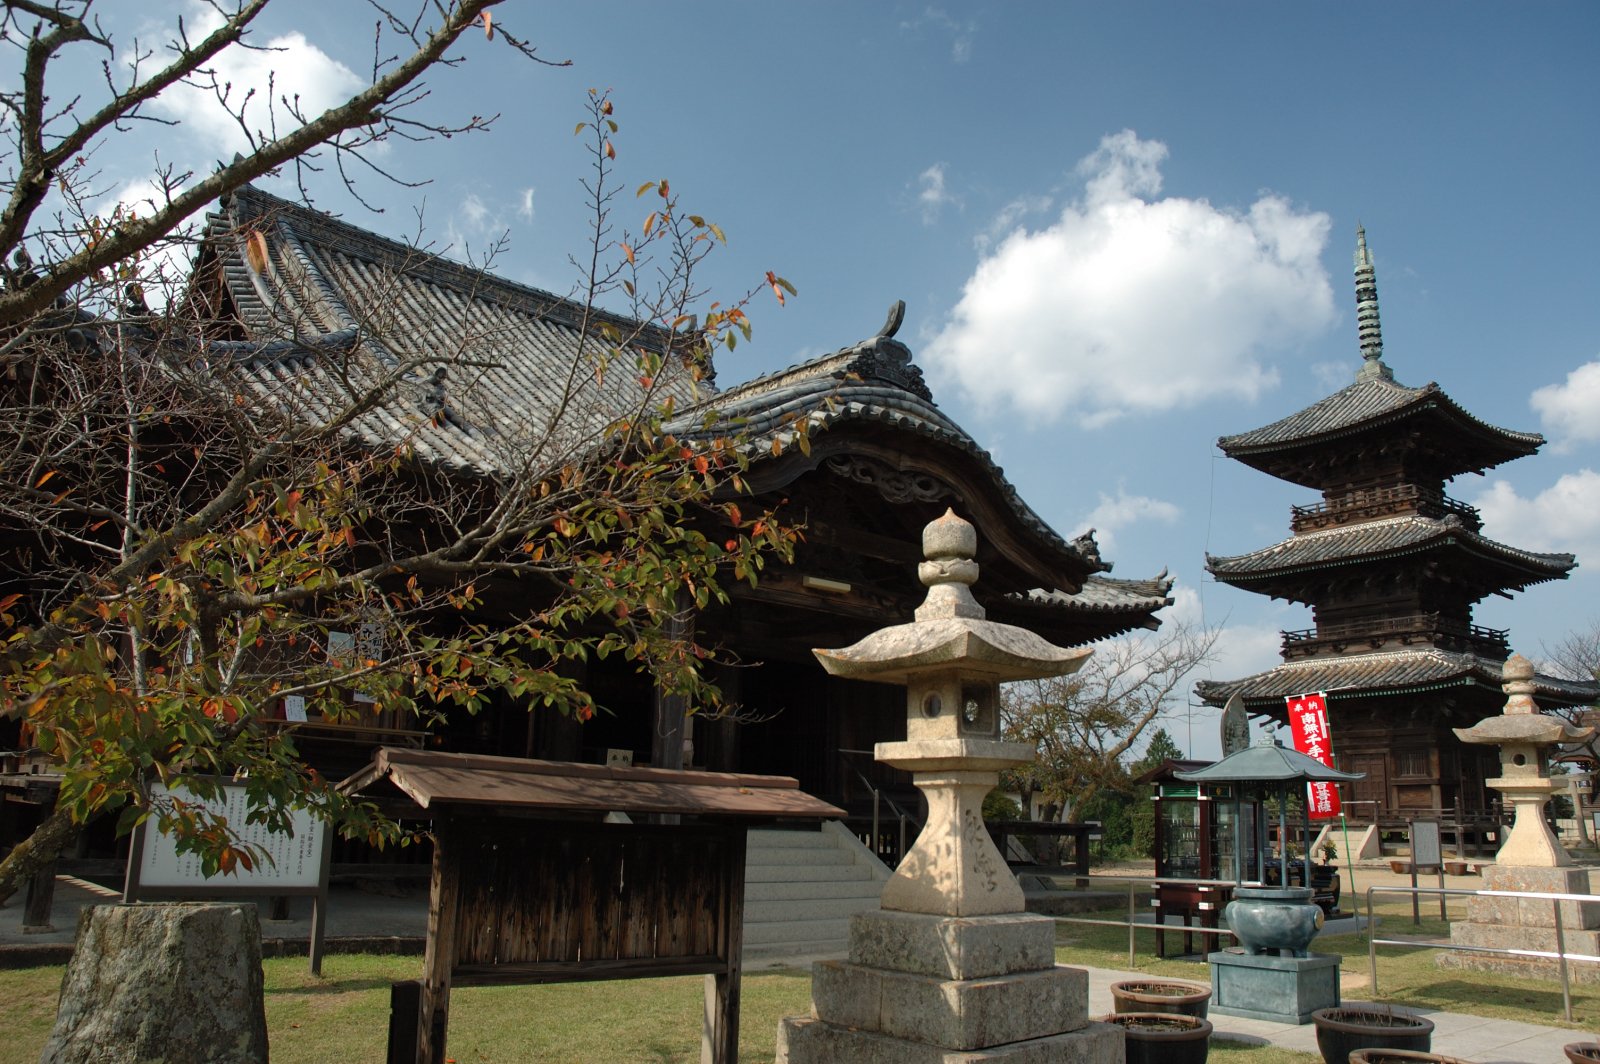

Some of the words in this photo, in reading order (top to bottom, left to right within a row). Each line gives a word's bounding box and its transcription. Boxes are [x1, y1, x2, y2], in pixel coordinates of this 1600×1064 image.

[1293, 701, 1318, 712] 奉納
[1300, 712, 1332, 813] 南無千手音菩薩
